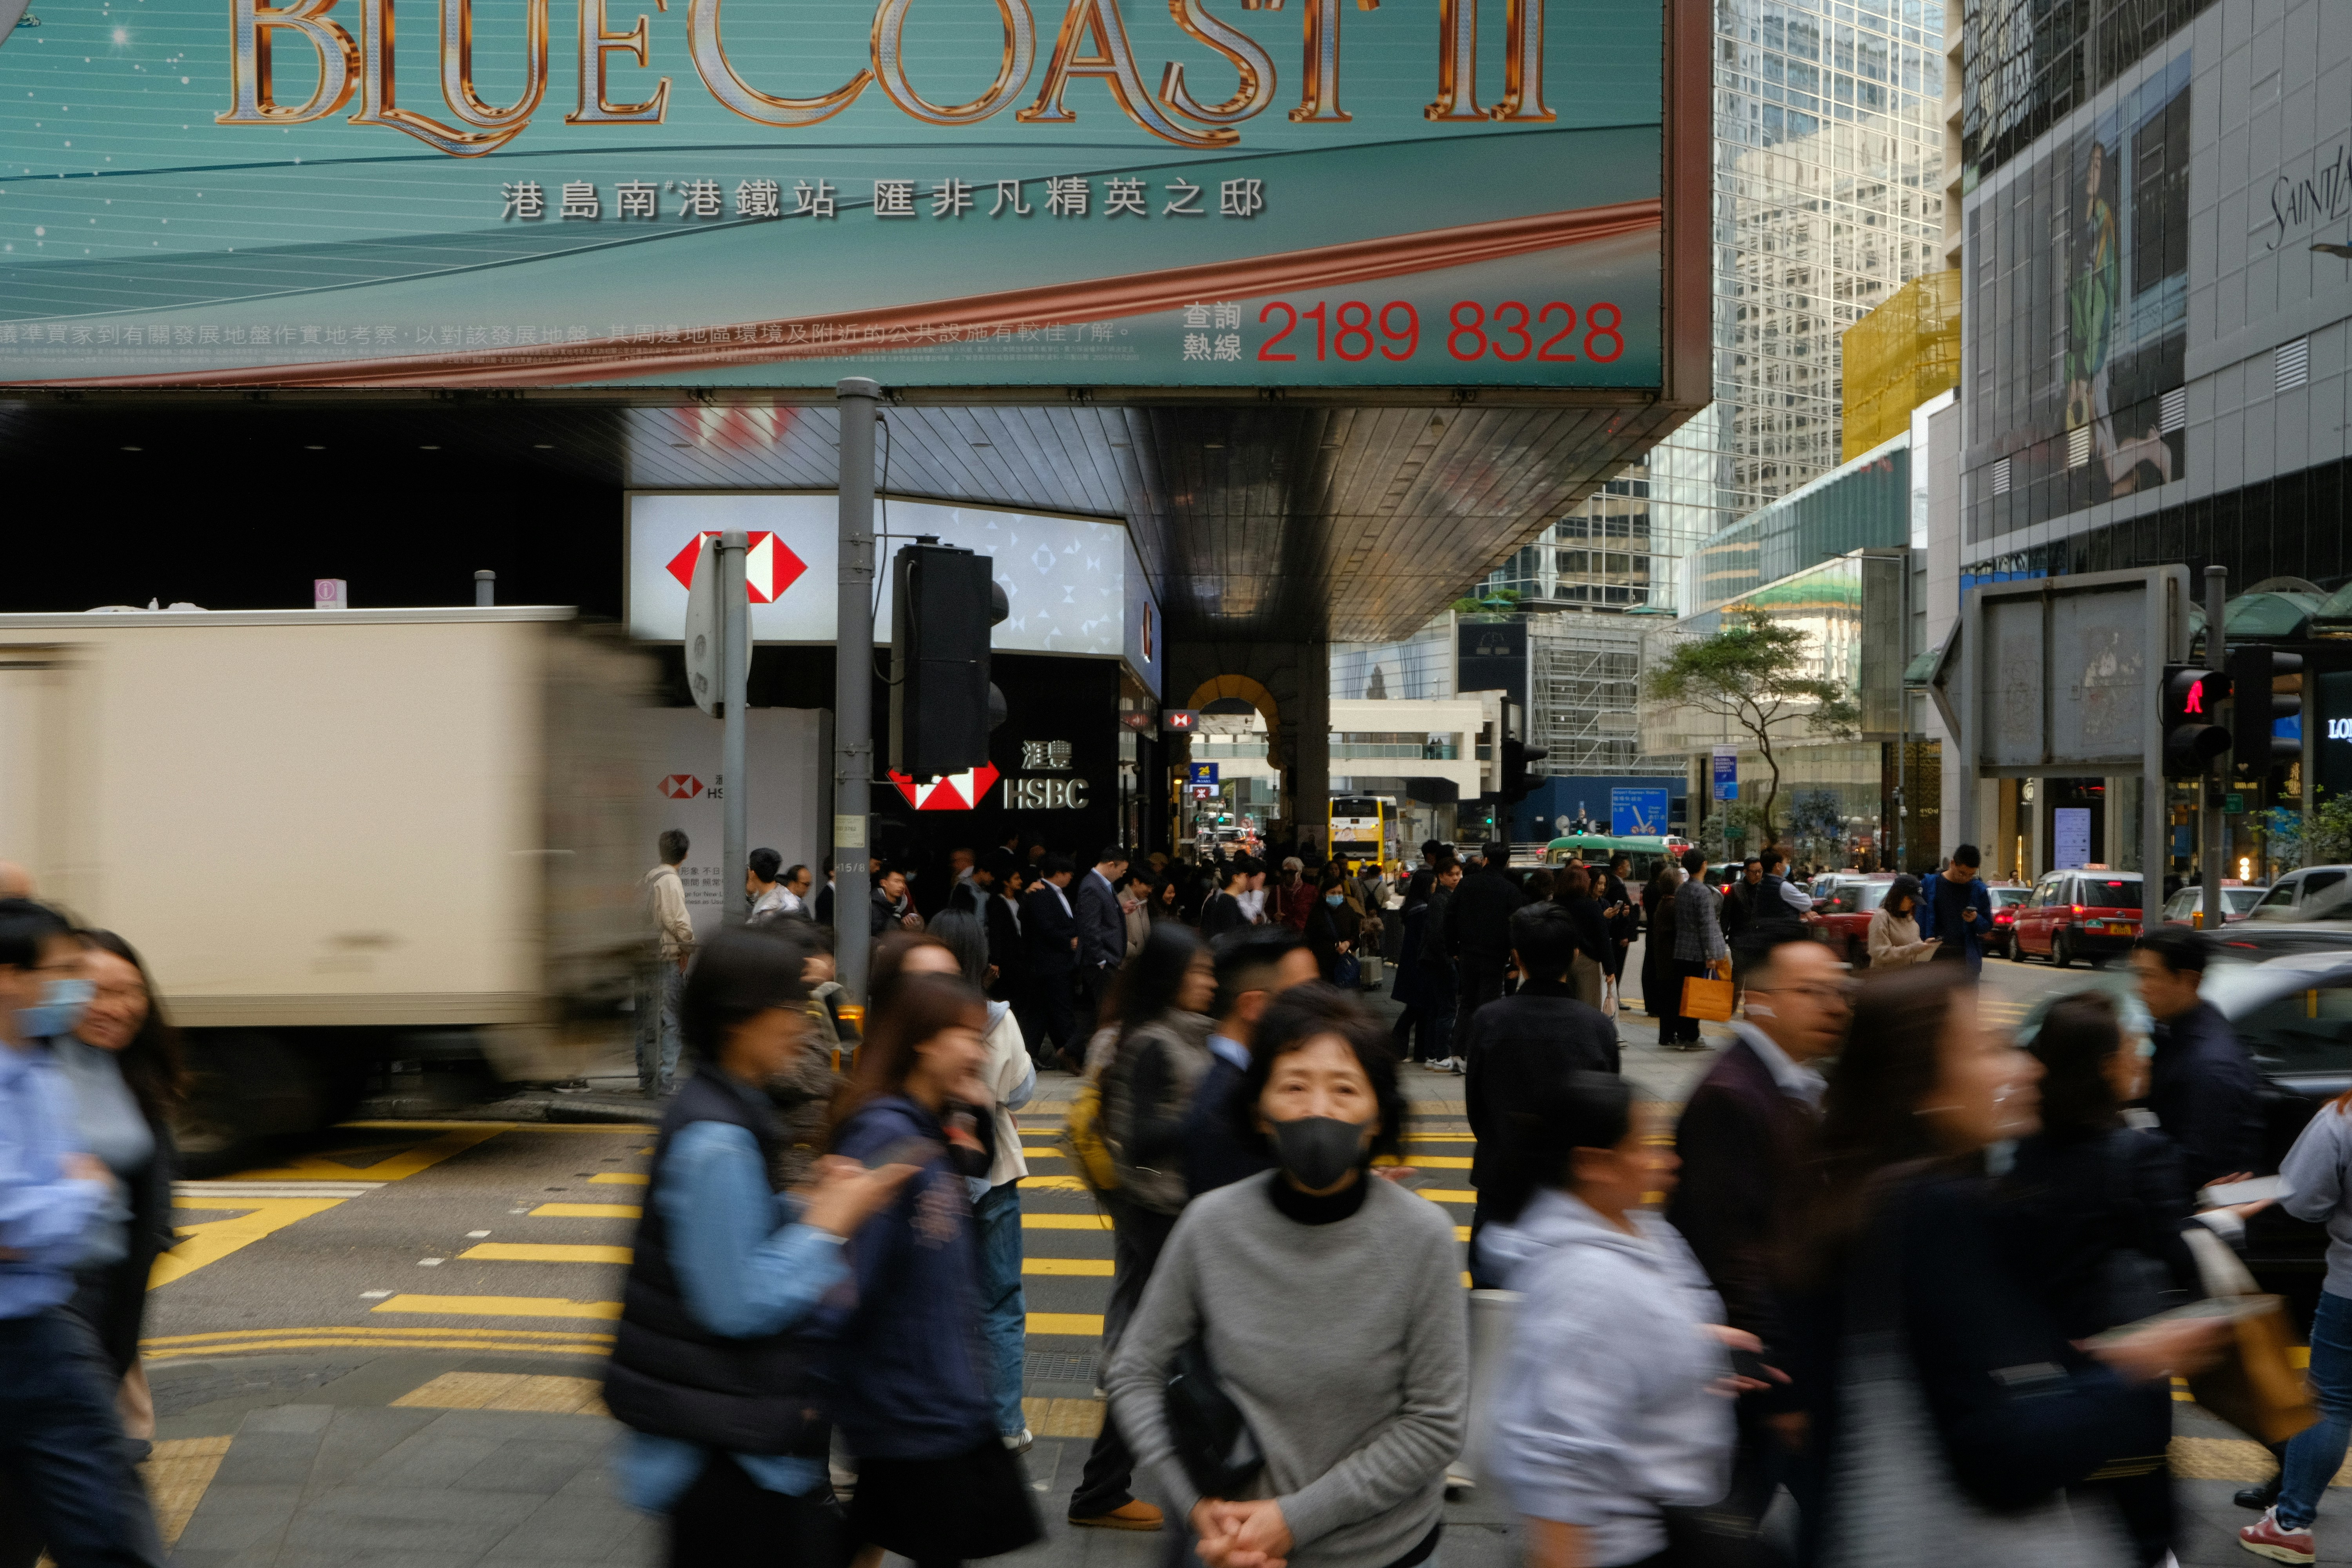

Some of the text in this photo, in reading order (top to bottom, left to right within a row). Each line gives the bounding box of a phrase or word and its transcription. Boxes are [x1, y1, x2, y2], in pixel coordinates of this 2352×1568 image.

[874, 177, 1262, 217] 匯非凡精英之邸
[1182, 301, 1242, 330] 查詢
[1257, 301, 1624, 363] 2189 8328
[1182, 333, 1242, 362] 熱線
[708, 788, 723, 799] HS
[715, 774, 723, 785] 滙
[1004, 779, 1089, 809] HSBC
